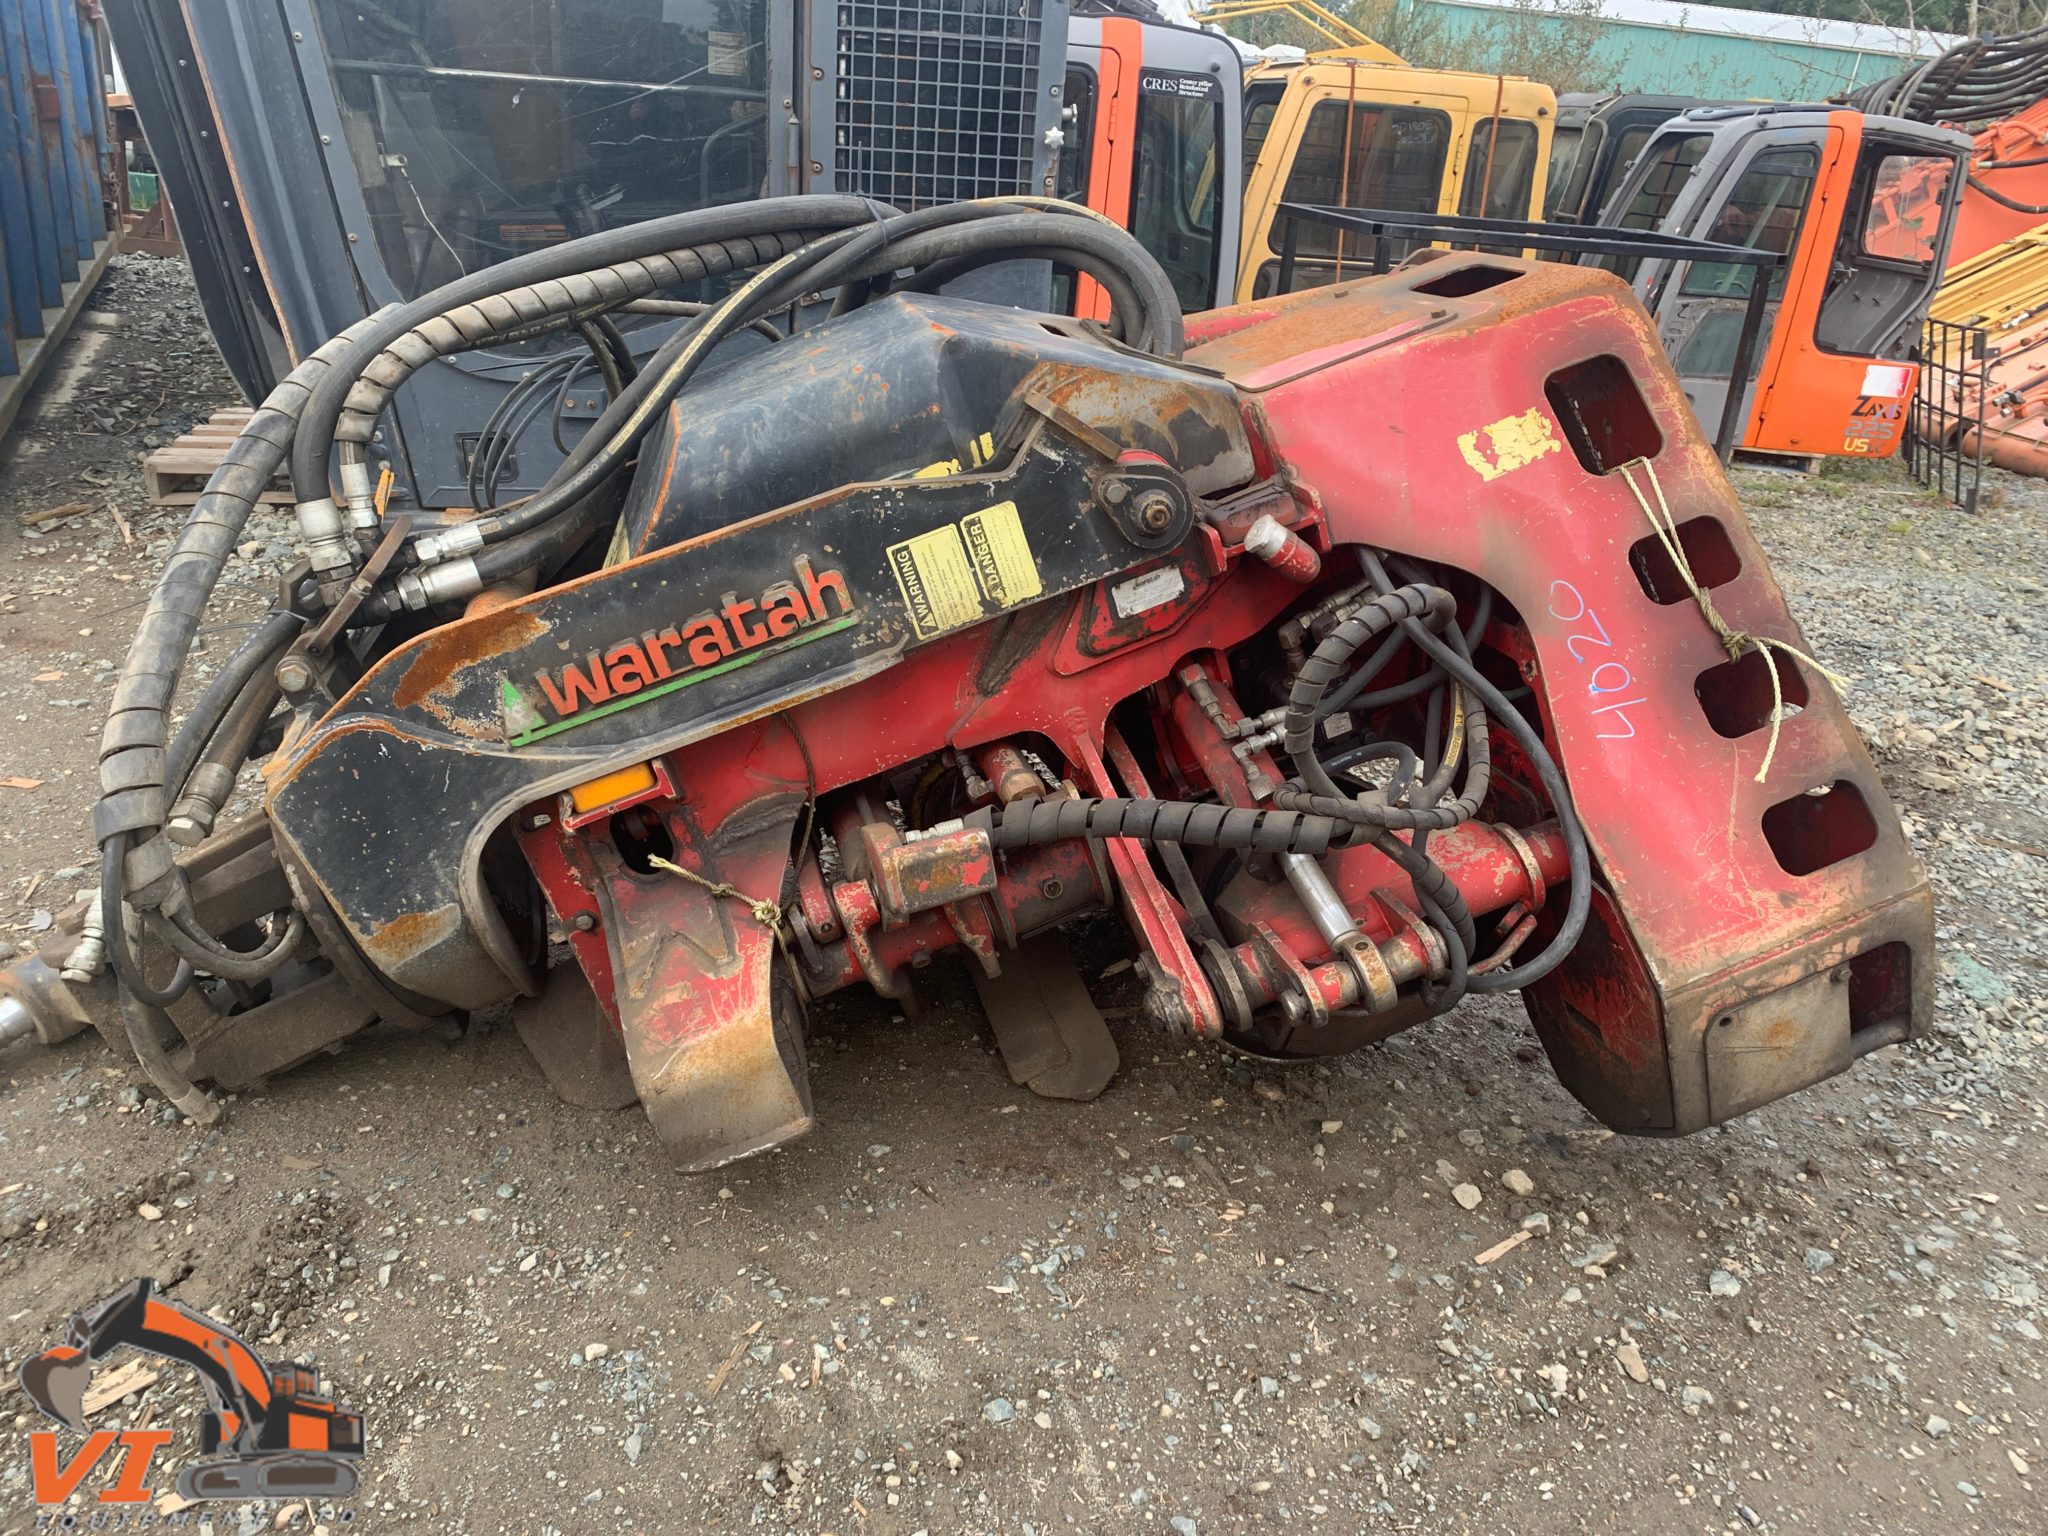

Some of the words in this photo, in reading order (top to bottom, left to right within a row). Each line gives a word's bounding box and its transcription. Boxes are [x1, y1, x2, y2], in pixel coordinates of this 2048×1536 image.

[1143, 77, 1177, 92] CRES
[1178, 89, 1204, 98] Structure
[1844, 419, 1895, 440] 225
[970, 524, 1001, 585] DANGER
[896, 549, 930, 616] WARNING
[535, 553, 856, 717] waratah
